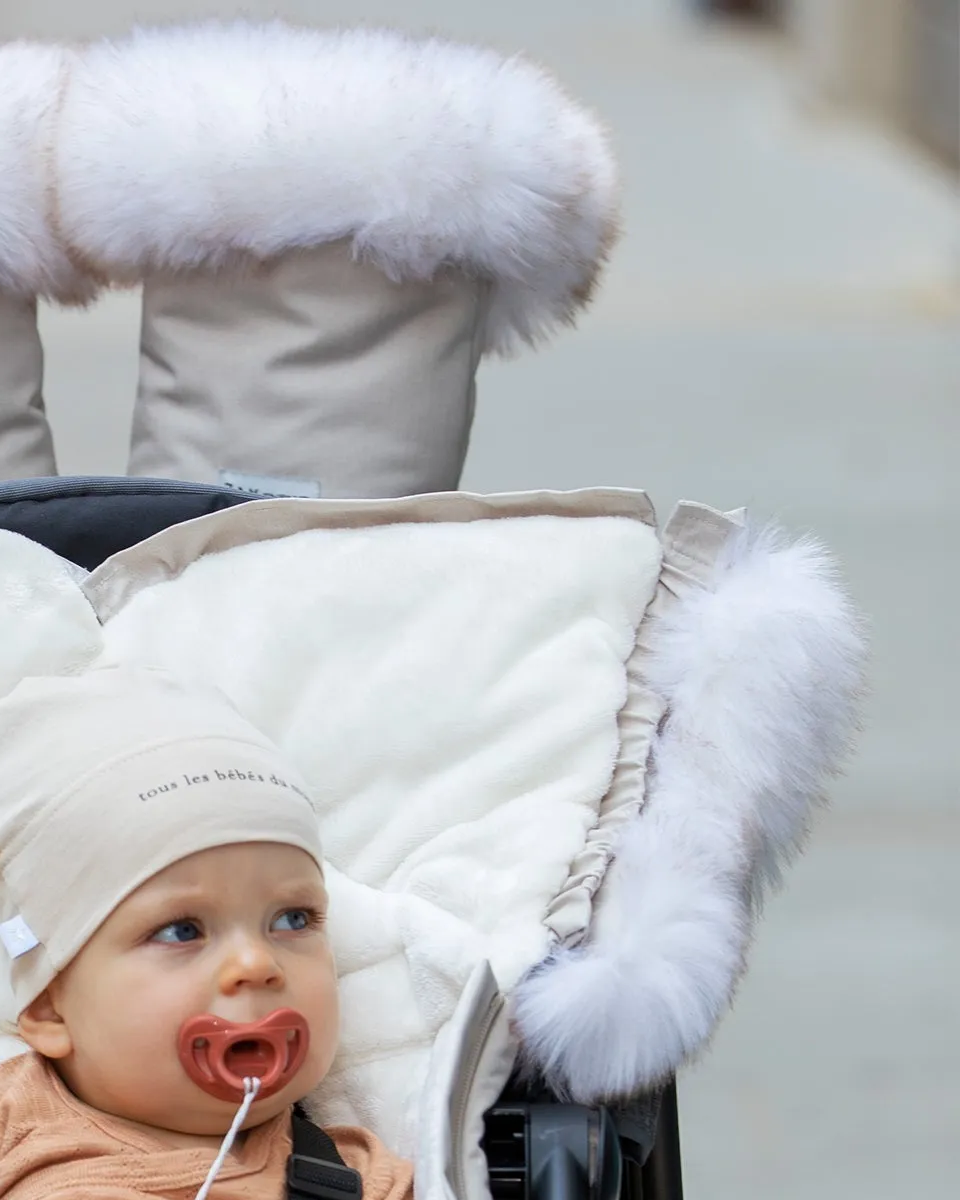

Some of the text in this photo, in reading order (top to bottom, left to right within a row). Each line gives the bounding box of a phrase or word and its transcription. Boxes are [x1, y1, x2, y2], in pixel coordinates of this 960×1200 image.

[138, 782, 178, 802] tous
[182, 774, 209, 786] les
[213, 768, 264, 783] bébés
